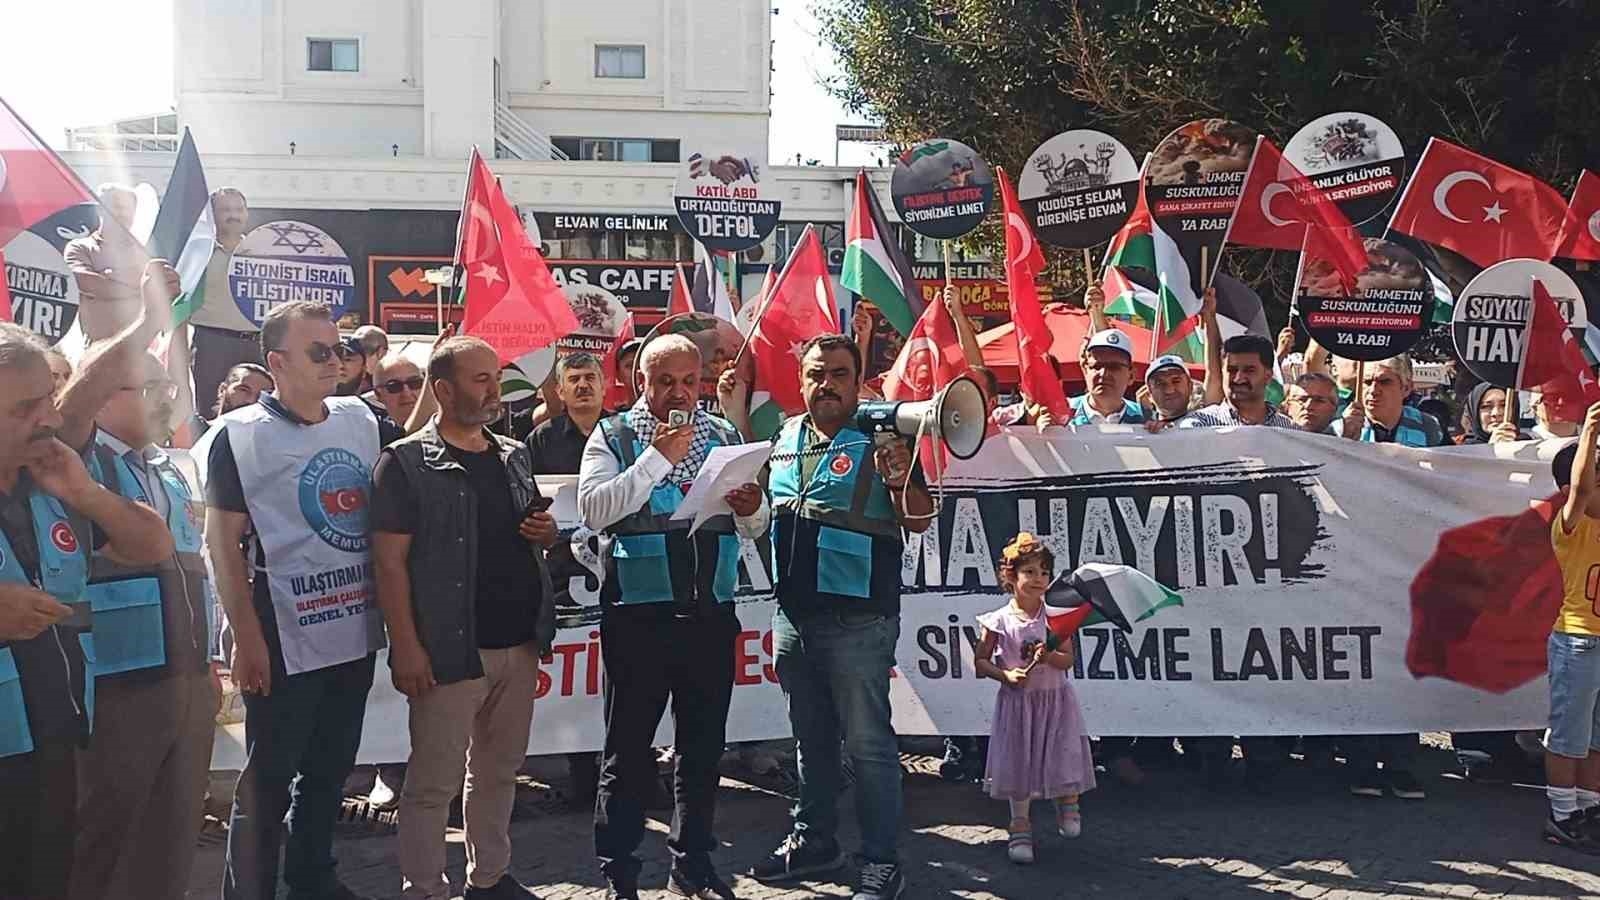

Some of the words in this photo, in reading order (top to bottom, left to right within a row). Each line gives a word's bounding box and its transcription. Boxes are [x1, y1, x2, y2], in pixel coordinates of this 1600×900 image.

[1346, 165, 1392, 183] ÖLÜYOR
[696, 185, 730, 198] KATİL
[733, 187, 757, 199] ABD
[1085, 187, 1122, 205] SELAM
[1332, 179, 1394, 200] SEYREDİYOR
[680, 199, 774, 215] ORTADOĞU'DAN
[904, 205, 955, 223] SİYONİZME
[956, 201, 985, 216] LANET
[1037, 208, 1086, 227] DİRENİŞE
[1088, 201, 1127, 218] DEVAM
[555, 216, 600, 228] ELVAN
[604, 214, 669, 231] GELİNLİK
[695, 213, 760, 239] DEFOL
[1181, 220, 1197, 231] YA
[5, 265, 64, 297] IRIMA
[234, 260, 302, 281] SİYONİST
[305, 265, 351, 285] İSRAİL
[599, 268, 674, 291] CAFE
[912, 265, 938, 280] VAN
[236, 279, 345, 306] FİLİSTİN'DEN
[1320, 299, 1422, 315] SUSKUNLUĞUNU
[1336, 332, 1354, 345] YA
[1356, 334, 1391, 346] RAB!
[1465, 326, 1523, 363] HAY
[1018, 492, 1282, 588] HAYIR!
[291, 562, 369, 596] ULAŞTIRM
[299, 608, 344, 626] GENEL
[1211, 626, 1382, 681] LANET
